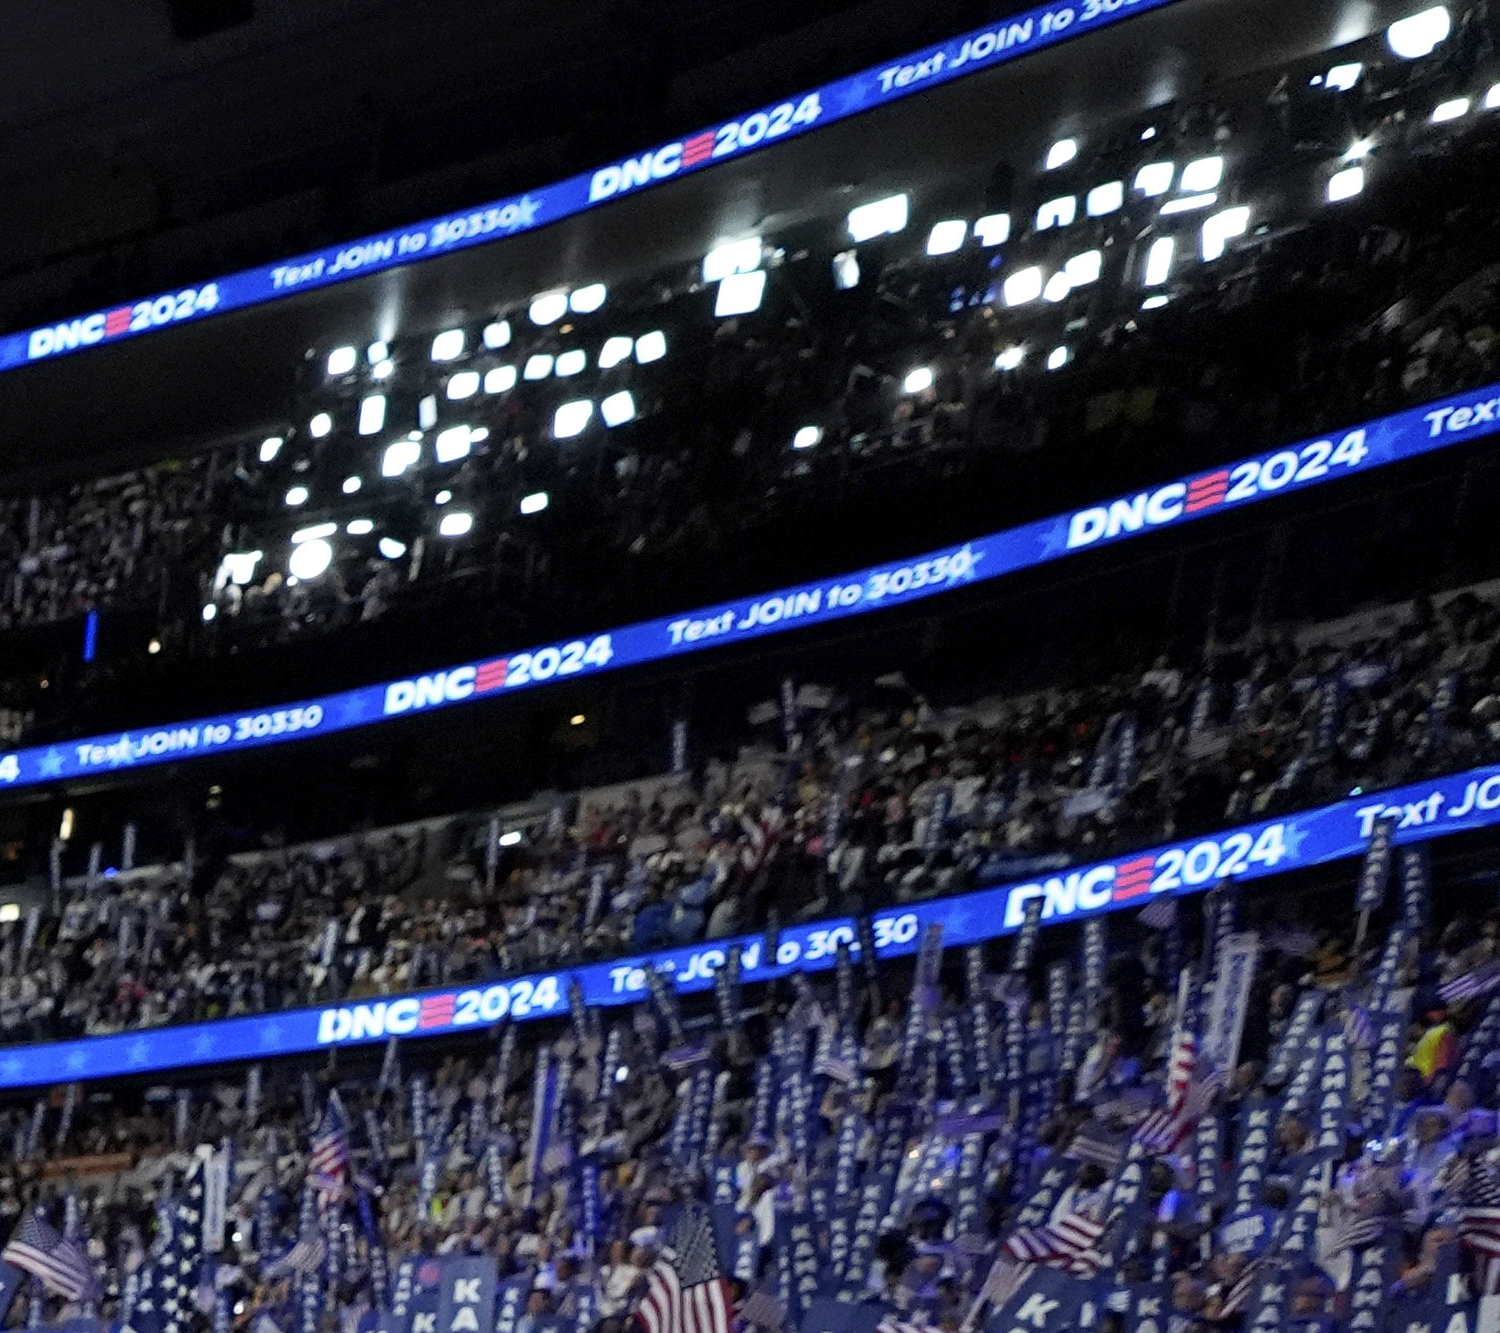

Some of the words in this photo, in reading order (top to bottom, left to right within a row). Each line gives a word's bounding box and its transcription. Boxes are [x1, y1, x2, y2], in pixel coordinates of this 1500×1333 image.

[878, 52, 946, 92] Text
[949, 18, 1033, 67] JOIN
[1041, 9, 1074, 34] to
[590, 143, 686, 201] DNC
[712, 94, 822, 157] 2024
[29, 313, 111, 358] DNC
[128, 284, 219, 331] 2024
[1067, 484, 1186, 547] DNC
[1224, 430, 1368, 502] 2024
[668, 611, 735, 643] Text
[738, 589, 821, 628] JOIN
[829, 585, 862, 607] to
[864, 544, 980, 600] 30330
[385, 666, 478, 714] DNC
[502, 635, 613, 687] 2024
[1005, 871, 1119, 930] DNC
[1148, 824, 1289, 892] 2024
[318, 999, 426, 1043] DNC
[445, 977, 560, 1025] 2024
